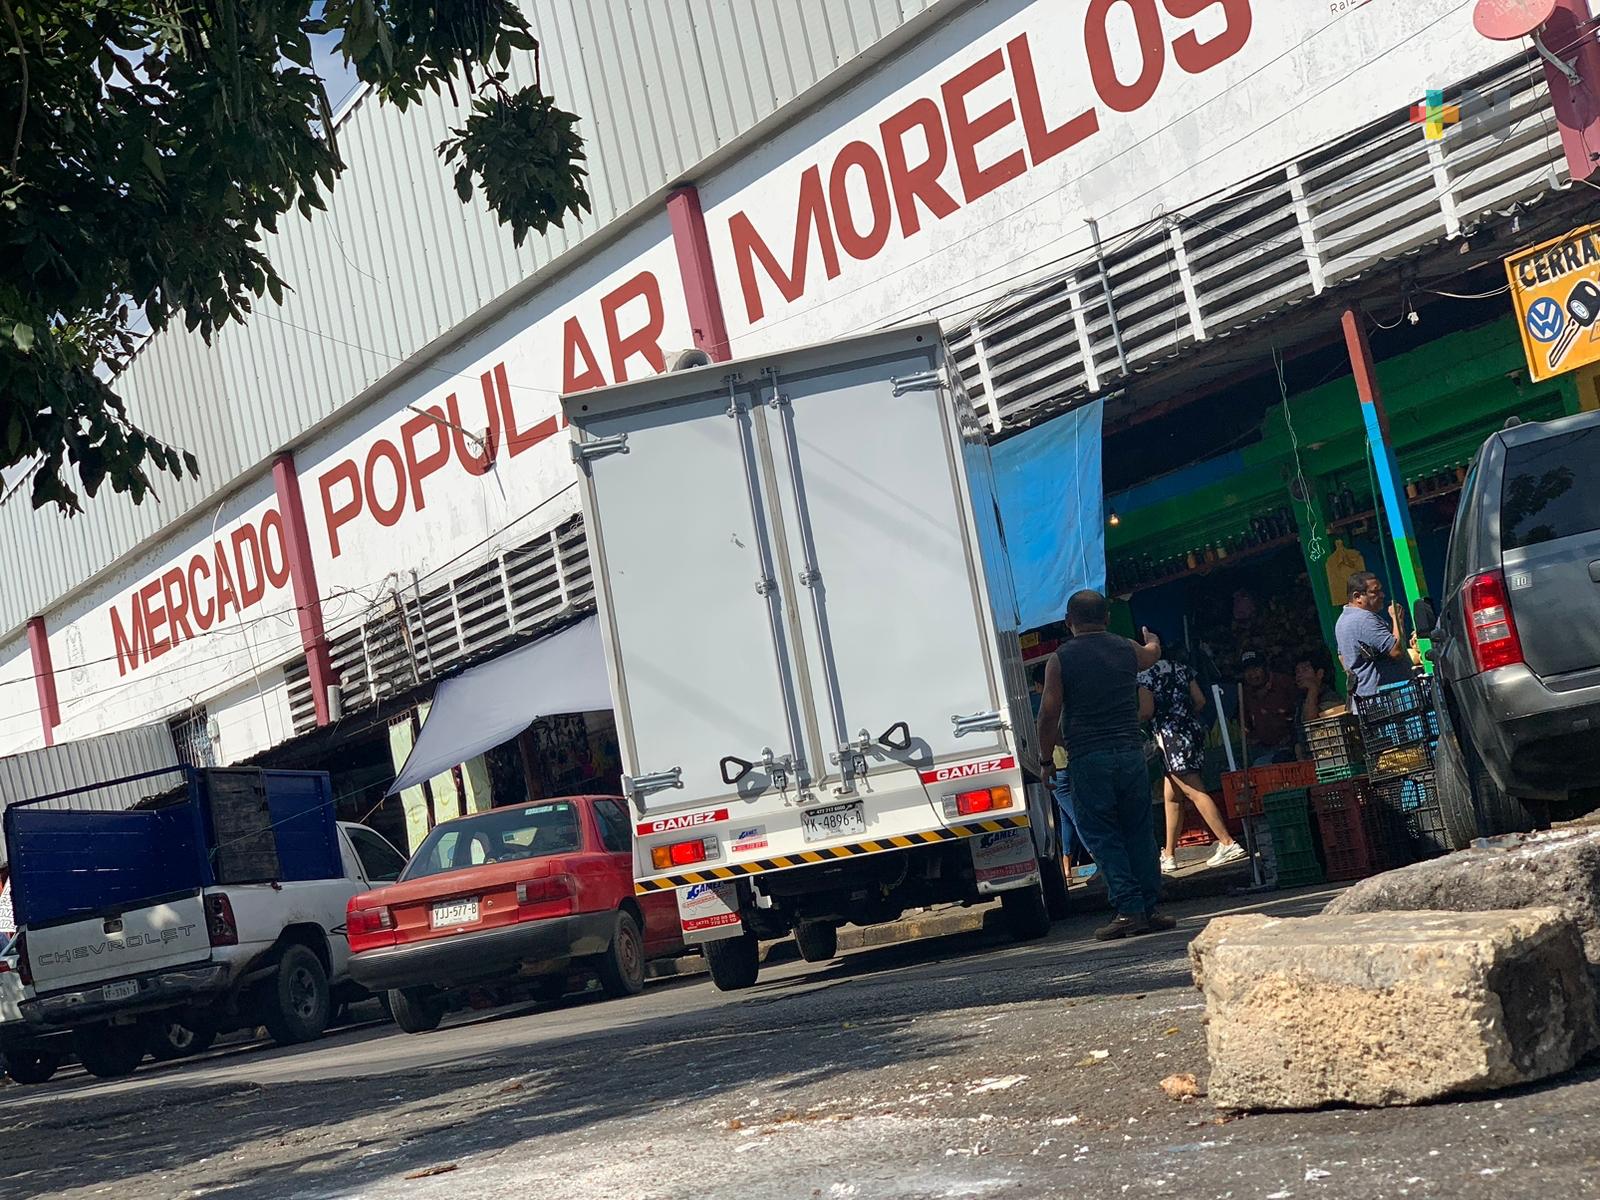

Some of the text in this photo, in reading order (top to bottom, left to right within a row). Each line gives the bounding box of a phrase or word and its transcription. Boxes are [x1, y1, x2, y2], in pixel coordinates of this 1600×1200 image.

[109, 0, 1252, 677] MERCADO POPULAR MORELOS
[937, 760, 1001, 780] GAMEZ
[653, 812, 715, 832] GAMEZ
[804, 810, 863, 832] YK-4896-A
[435, 903, 477, 920] YJJ-577-B
[38, 924, 197, 966] CHEVROLET
